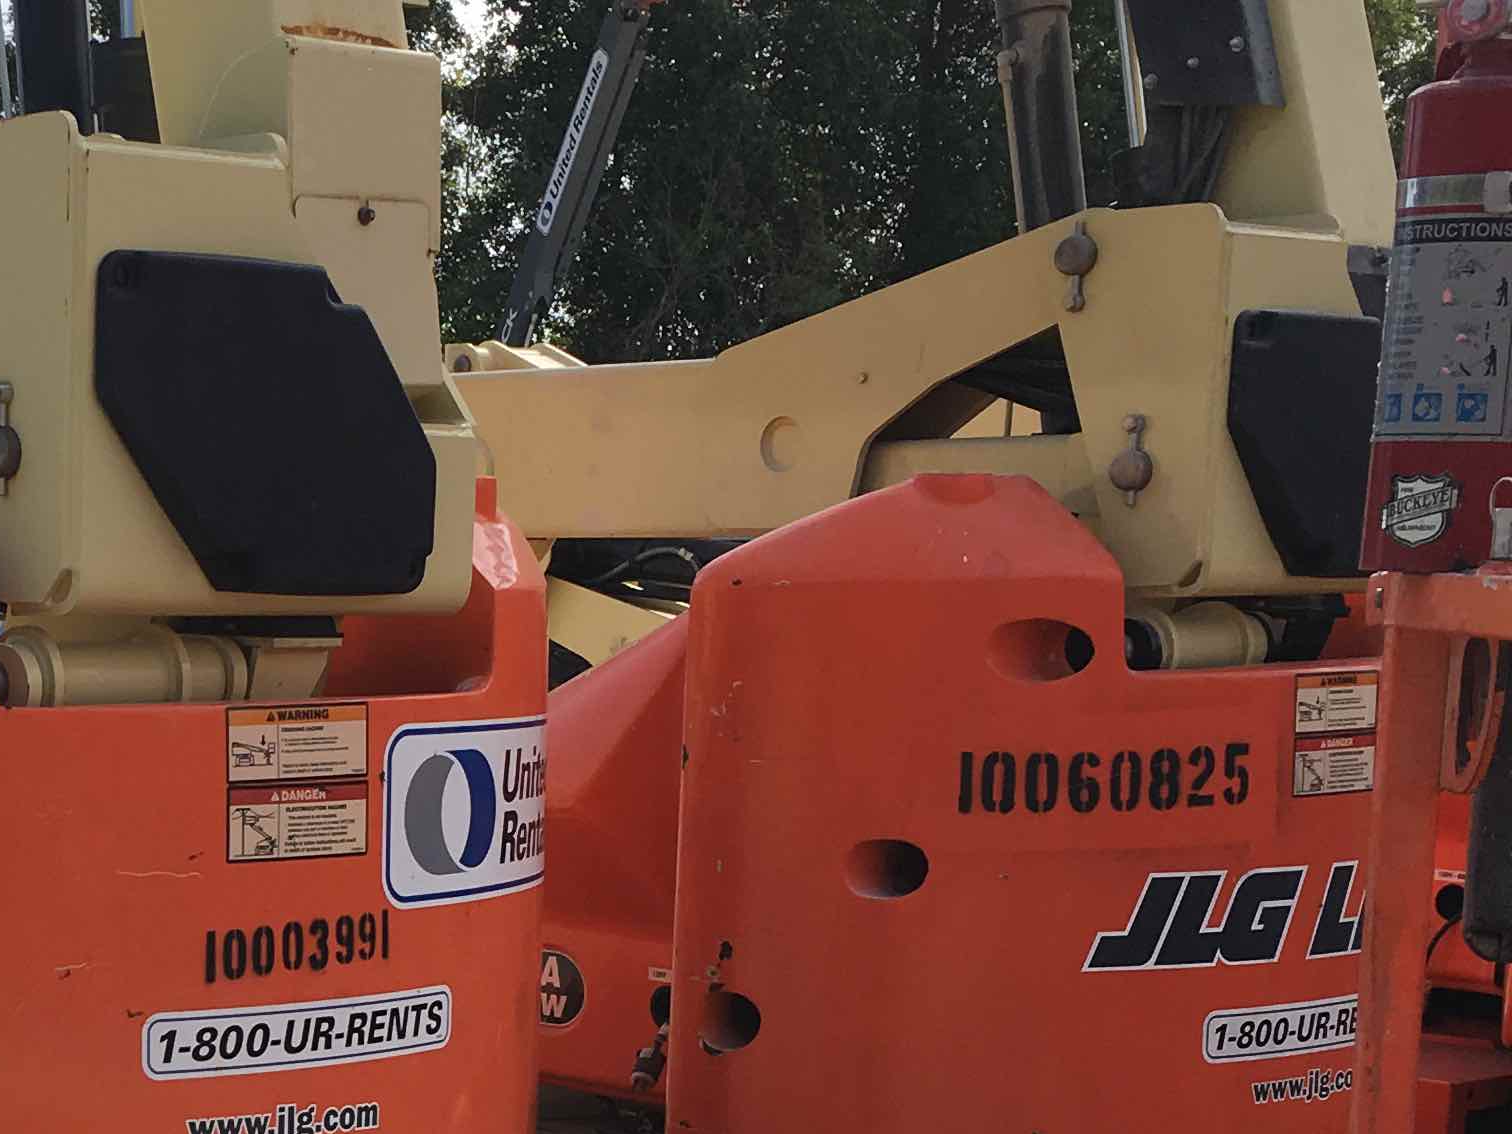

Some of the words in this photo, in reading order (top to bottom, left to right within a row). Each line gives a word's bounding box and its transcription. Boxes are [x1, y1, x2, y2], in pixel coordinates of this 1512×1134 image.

[550, 133, 577, 200] United
[573, 60, 604, 137] Rentals
[277, 709, 329, 721] WARNING
[281, 788, 327, 801] DANGER
[958, 743, 1251, 814] 10060825
[205, 909, 390, 984] 10003991
[1082, 865, 1309, 972] JLG
[159, 1000, 444, 1064] 1-800-UR-RENTS
